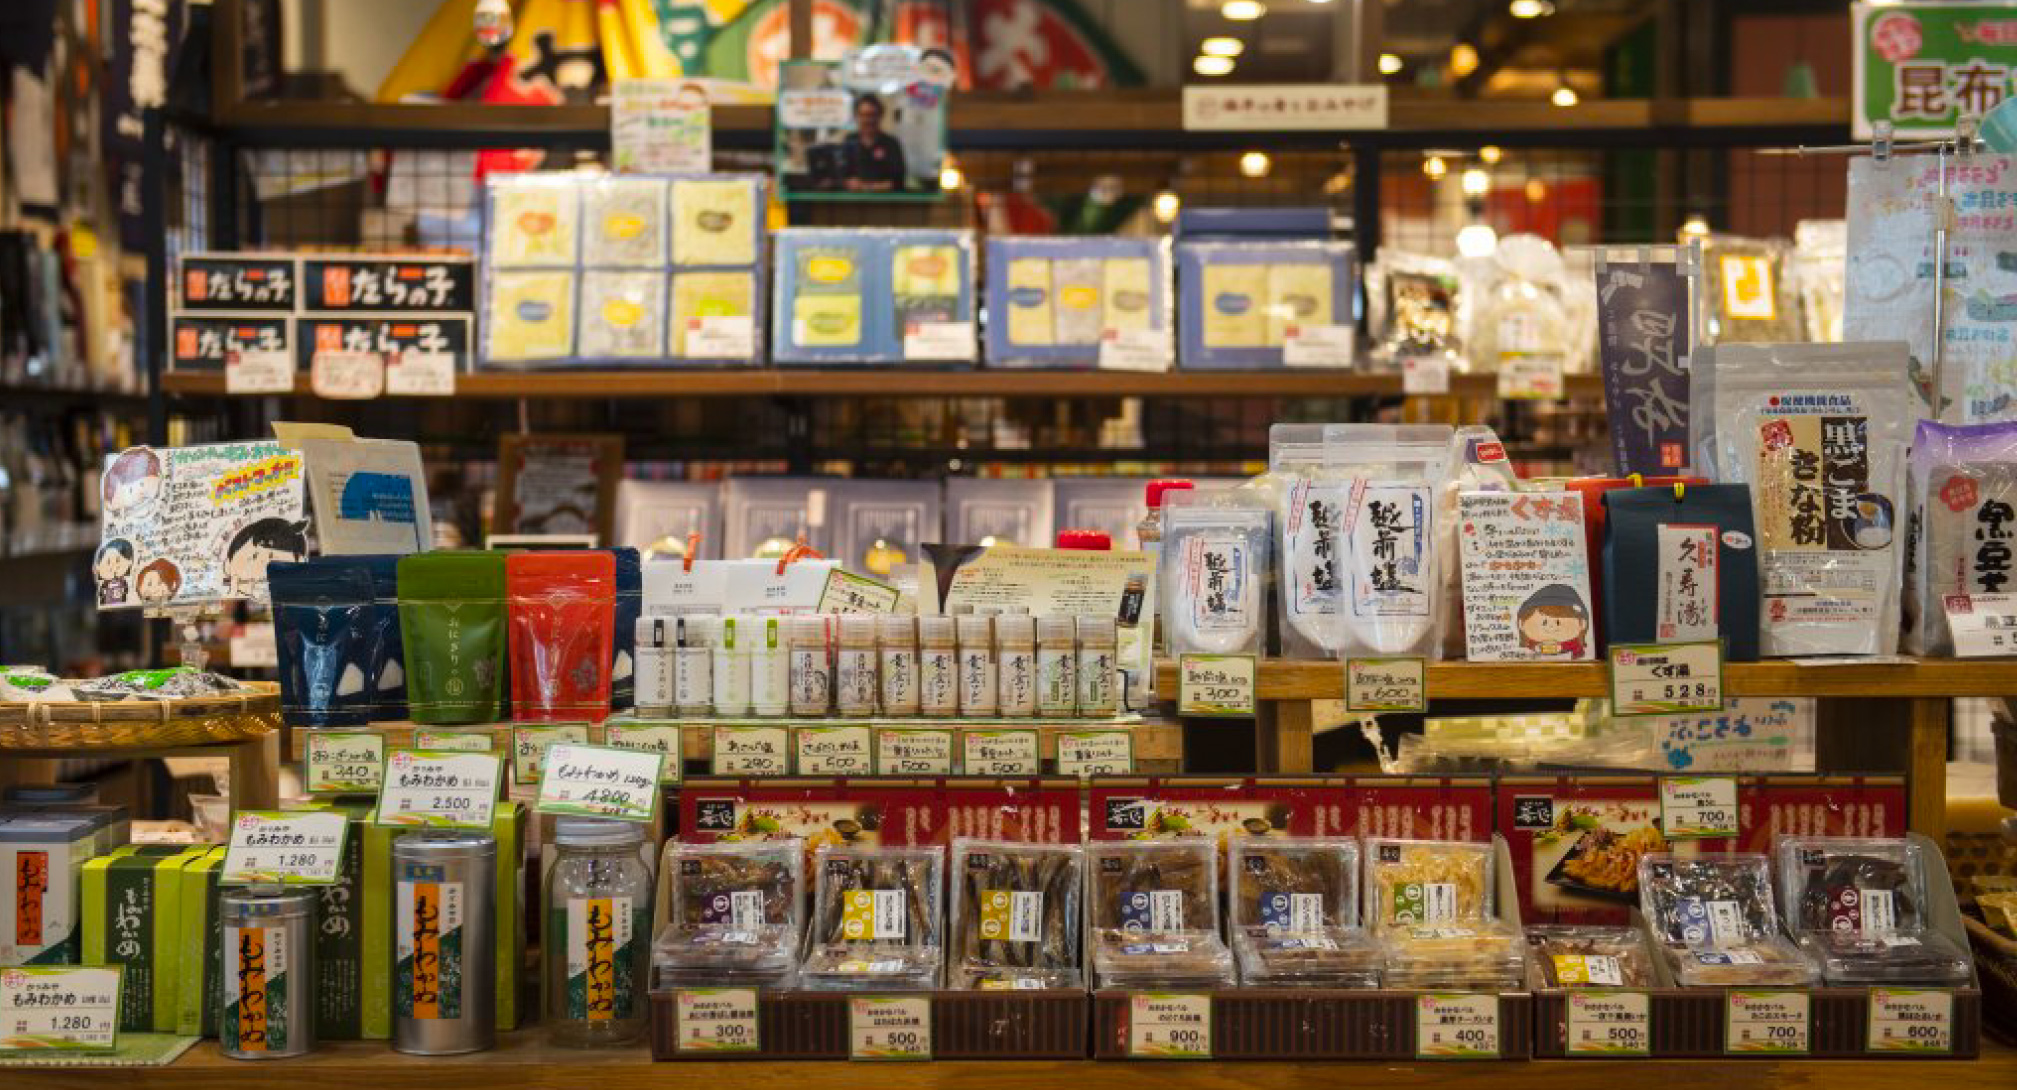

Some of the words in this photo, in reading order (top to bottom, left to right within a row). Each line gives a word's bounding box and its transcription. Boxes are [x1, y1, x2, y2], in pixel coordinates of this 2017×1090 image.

[1896, 66, 2004, 115] 昆布
[352, 265, 456, 306] たらの子
[199, 326, 283, 359] たら子
[345, 323, 449, 354] たら子
[1824, 421, 1864, 520] 黒ごま
[1789, 448, 1827, 546] きな粉
[1651, 663, 1691, 678] くず湯
[1204, 687, 1240, 700] 300
[1374, 687, 1409, 699] 600
[741, 757, 774, 770] 290
[826, 758, 856, 769] 500
[901, 758, 933, 772] 500
[990, 761, 1024, 774] 500
[334, 765, 369, 779] 240
[400, 774, 458, 787] もみわかめ
[1697, 811, 1724, 823] 700
[245, 833, 305, 846] もみわかめ
[13, 992, 77, 1007] もみわかめ
[716, 1024, 744, 1036] 300
[1169, 1030, 1199, 1042] 900
[1456, 1030, 1485, 1042] 400
[1608, 1027, 1637, 1039] 500
[1767, 1026, 1796, 1038] 700
[1907, 1026, 1938, 1037] 600
[887, 1032, 917, 1044] 500
